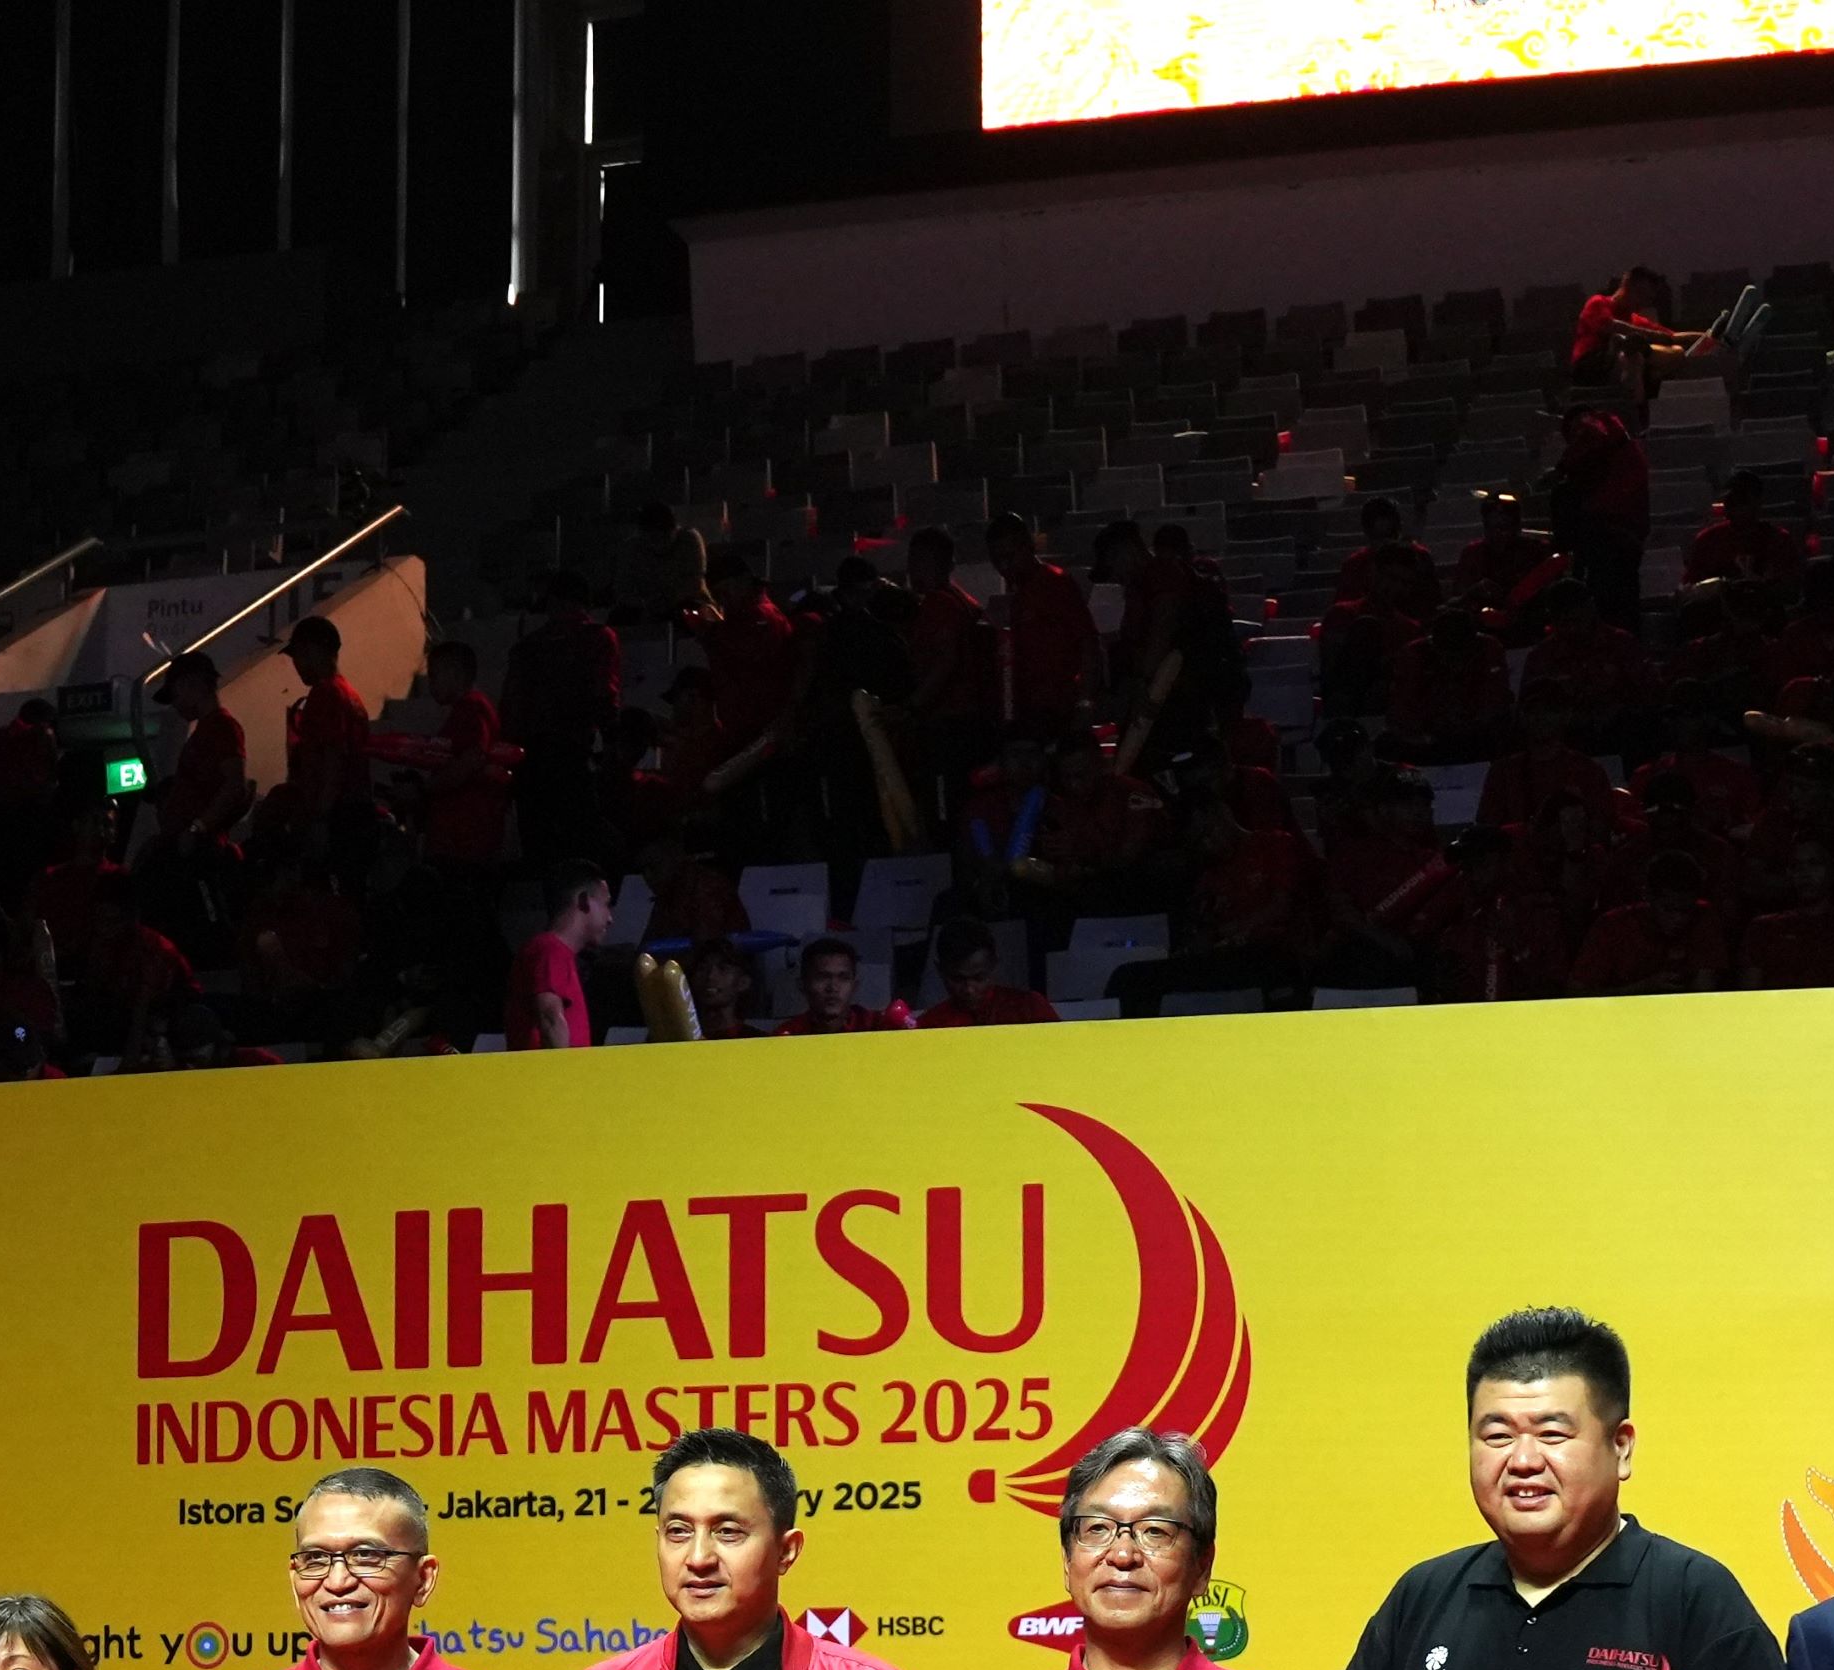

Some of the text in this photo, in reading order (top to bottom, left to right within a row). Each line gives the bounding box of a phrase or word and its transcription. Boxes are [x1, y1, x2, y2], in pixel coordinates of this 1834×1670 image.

[136, 1184, 1045, 1379] DAIHATSU
[136, 1376, 1053, 1466] INDONESIA MASTERS 2025
[178, 1498, 265, 1525] Istora
[437, 1490, 564, 1521] Jakarta,
[575, 1488, 605, 1516] 21
[833, 1481, 922, 1511] 2025
[414, 1617, 525, 1654] hatsu
[877, 1616, 945, 1637] HSBC
[1016, 1616, 1084, 1636] BWF
[1588, 1647, 1659, 1668] DAIHATSU
